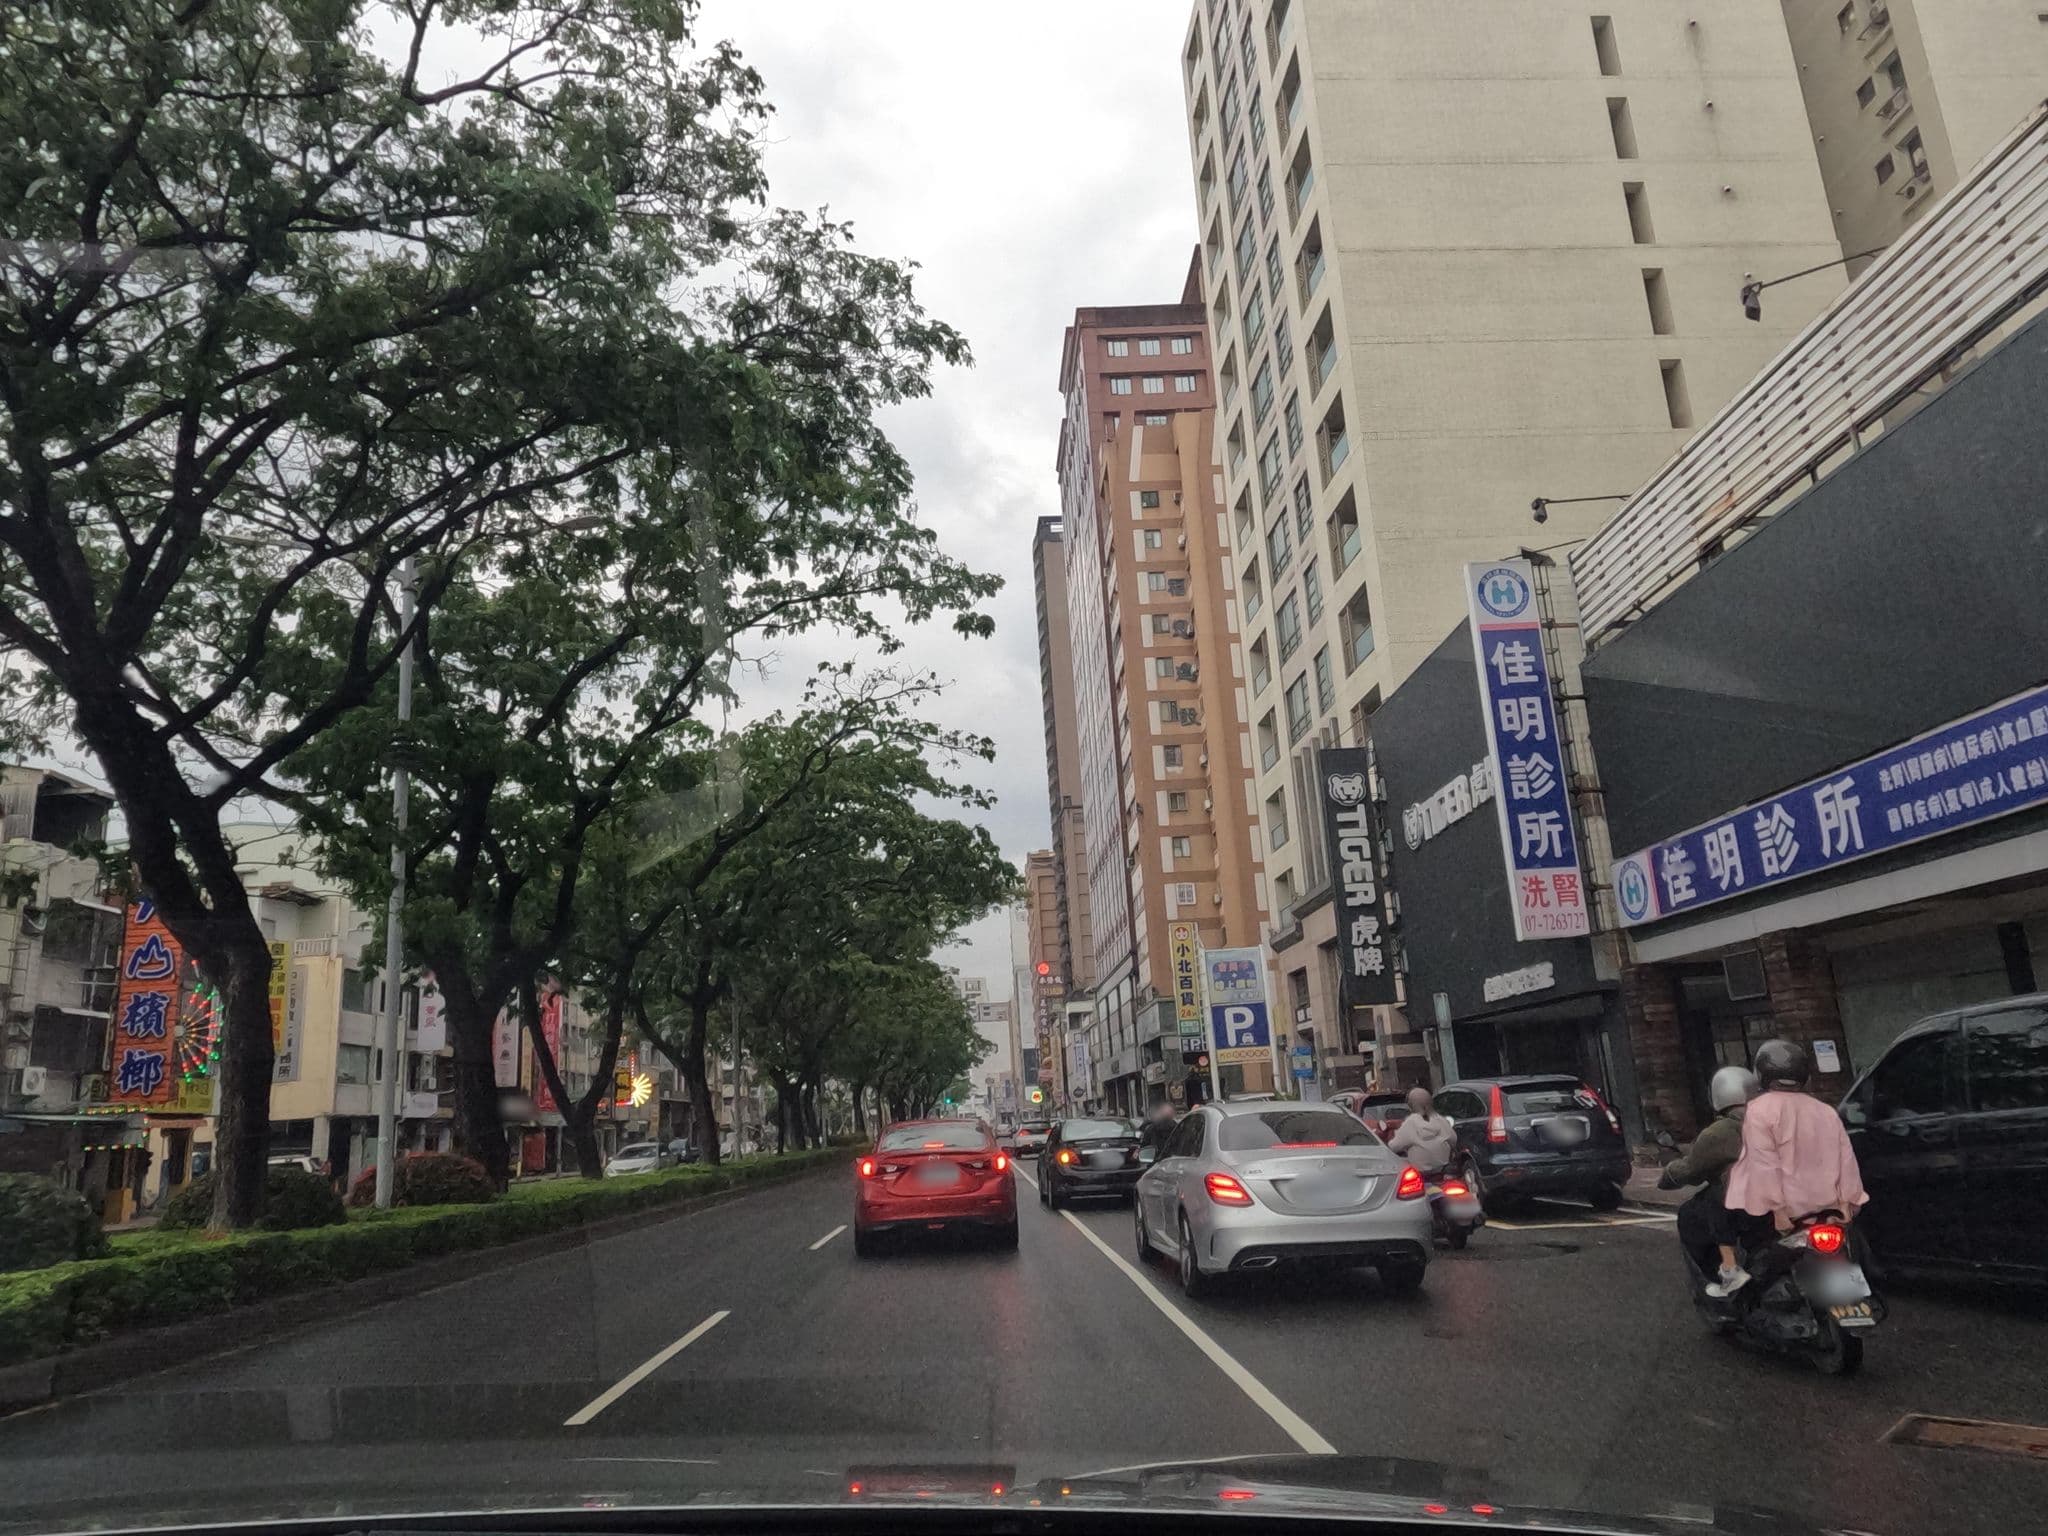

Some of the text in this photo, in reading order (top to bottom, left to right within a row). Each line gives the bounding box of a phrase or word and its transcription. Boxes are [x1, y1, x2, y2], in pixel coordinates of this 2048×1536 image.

[1490, 640, 1564, 860] 佳明診所
[1419, 773, 1473, 841] TIGER
[1336, 803, 1377, 907] TIGER
[1660, 775, 1864, 908] 佳明診所
[1521, 873, 1580, 909] 洗腎
[1525, 911, 1586, 933] 07-7263727
[1176, 943, 1195, 1007] 小北百貨
[1351, 914, 1384, 977] 虎牌
[115, 896, 174, 1095] 山檳榔
[1224, 1006, 1254, 1047] P
